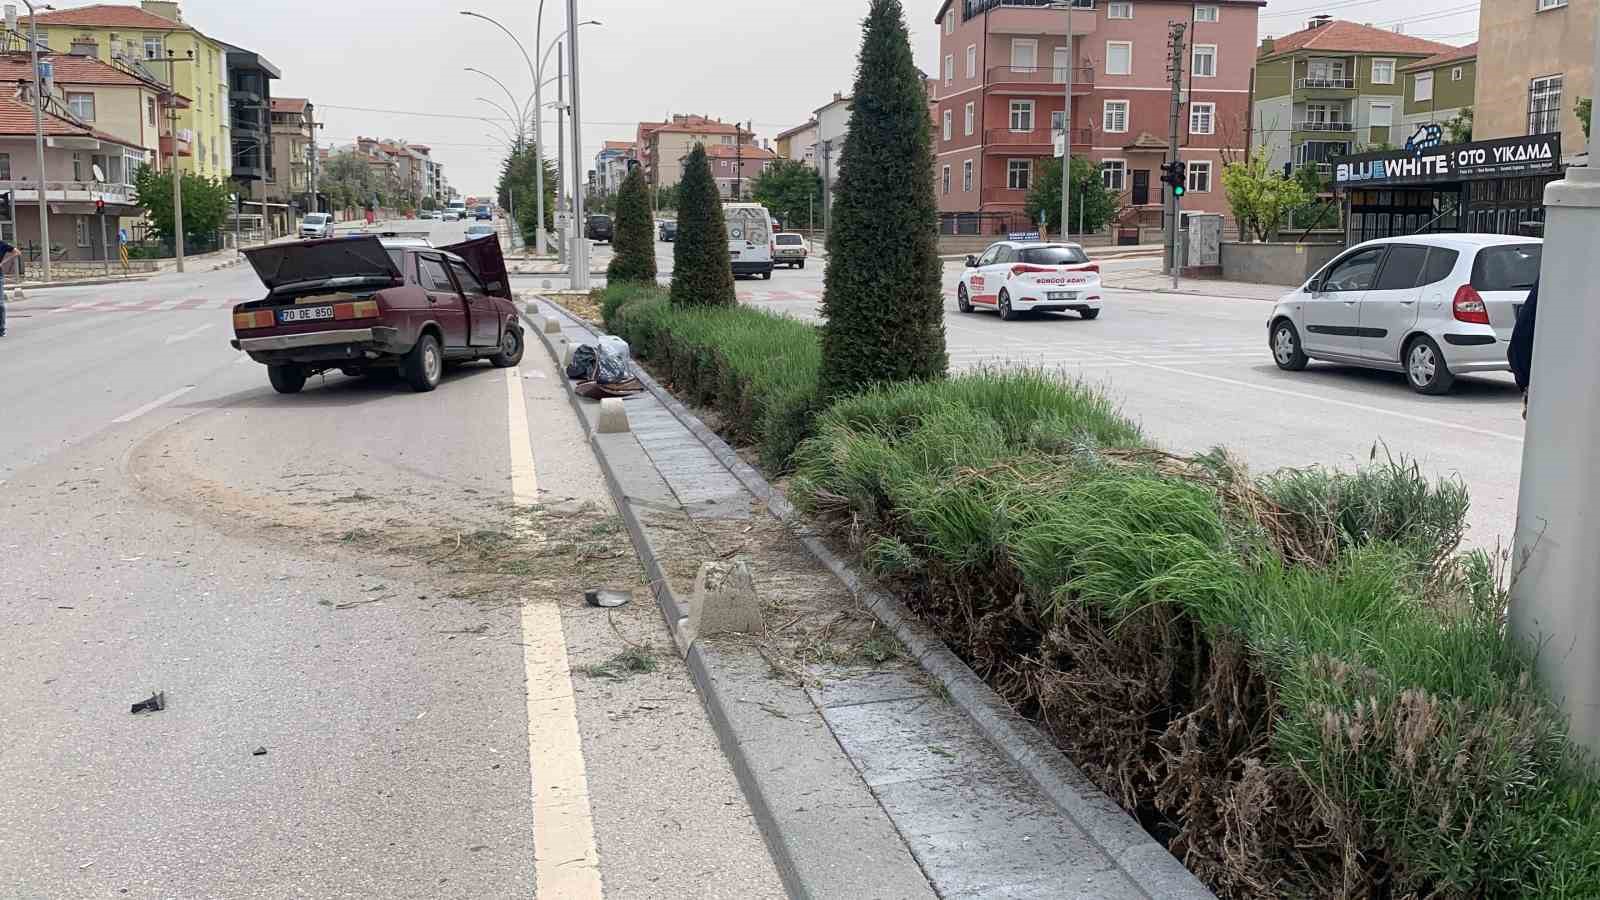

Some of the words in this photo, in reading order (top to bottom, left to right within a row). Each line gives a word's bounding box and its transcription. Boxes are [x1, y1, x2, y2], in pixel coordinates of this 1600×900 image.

[1458, 149, 1486, 166] OTO
[1493, 142, 1553, 163] YIKAMA
[284, 310, 295, 320] 70
[300, 309, 311, 319] DE
[315, 307, 332, 317] 850
